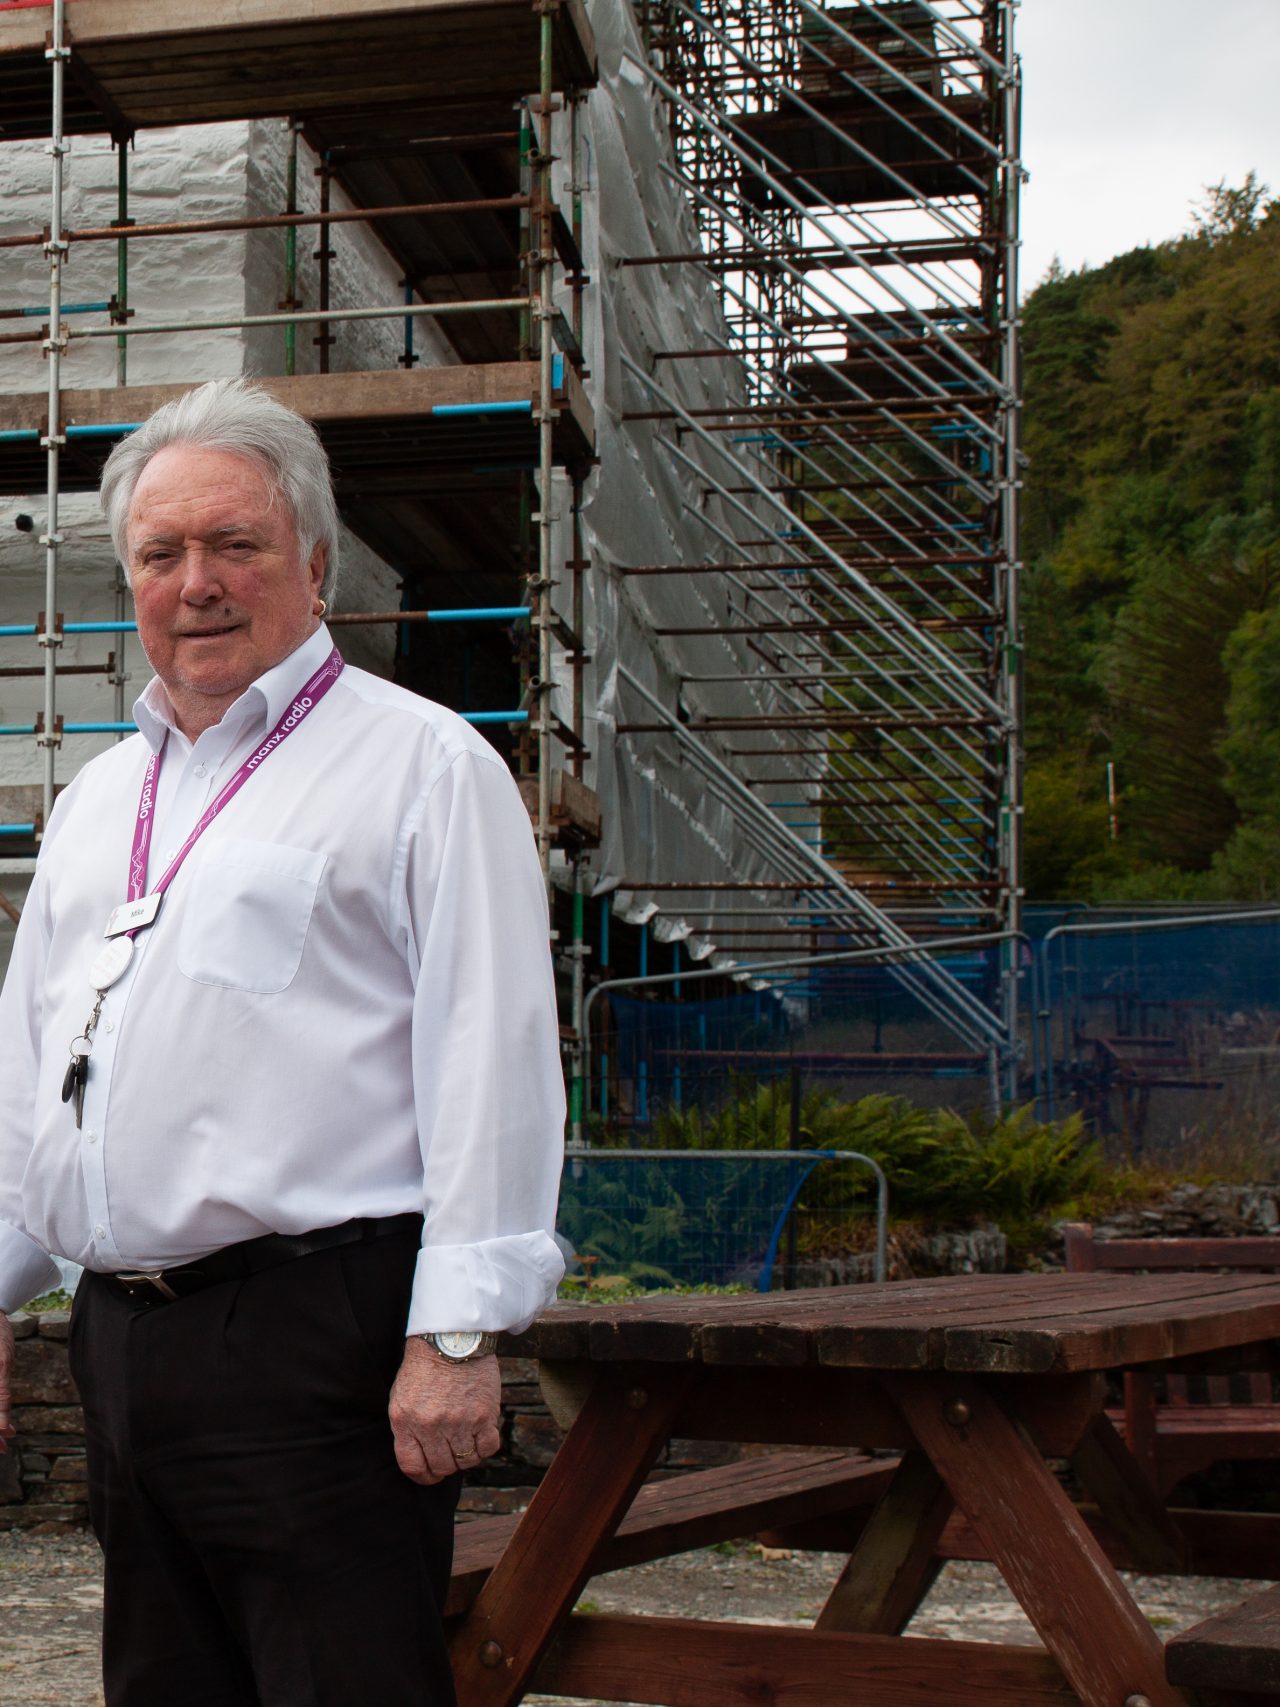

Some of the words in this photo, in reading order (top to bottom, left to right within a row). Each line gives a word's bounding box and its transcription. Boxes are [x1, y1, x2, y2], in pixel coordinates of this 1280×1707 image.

[246, 732, 285, 770] manx
[281, 697, 313, 732] radio
[139, 783, 153, 819] radio
